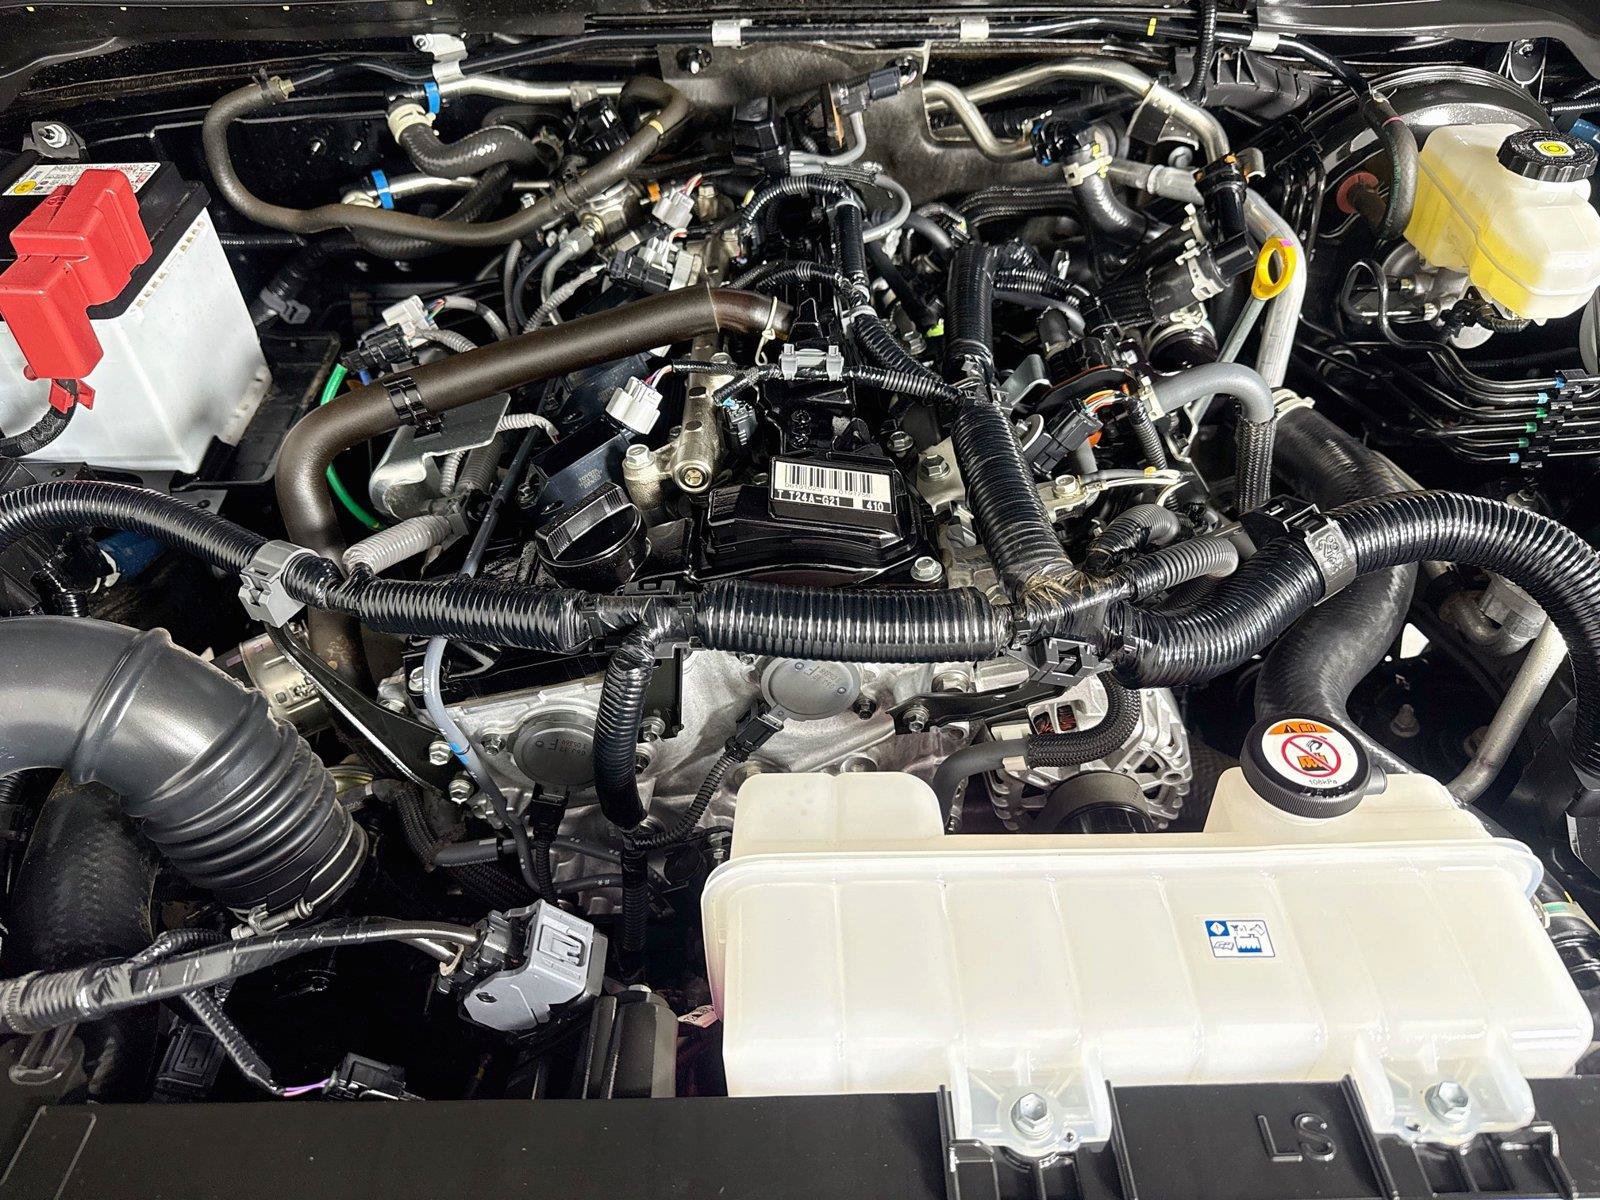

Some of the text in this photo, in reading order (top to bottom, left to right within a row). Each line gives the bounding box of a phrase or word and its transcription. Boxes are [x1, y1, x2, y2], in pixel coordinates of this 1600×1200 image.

[777, 490, 784, 499] T
[789, 491, 840, 507] T24A-G21
[866, 501, 884, 511] 410
[1257, 1112, 1337, 1162] LS
